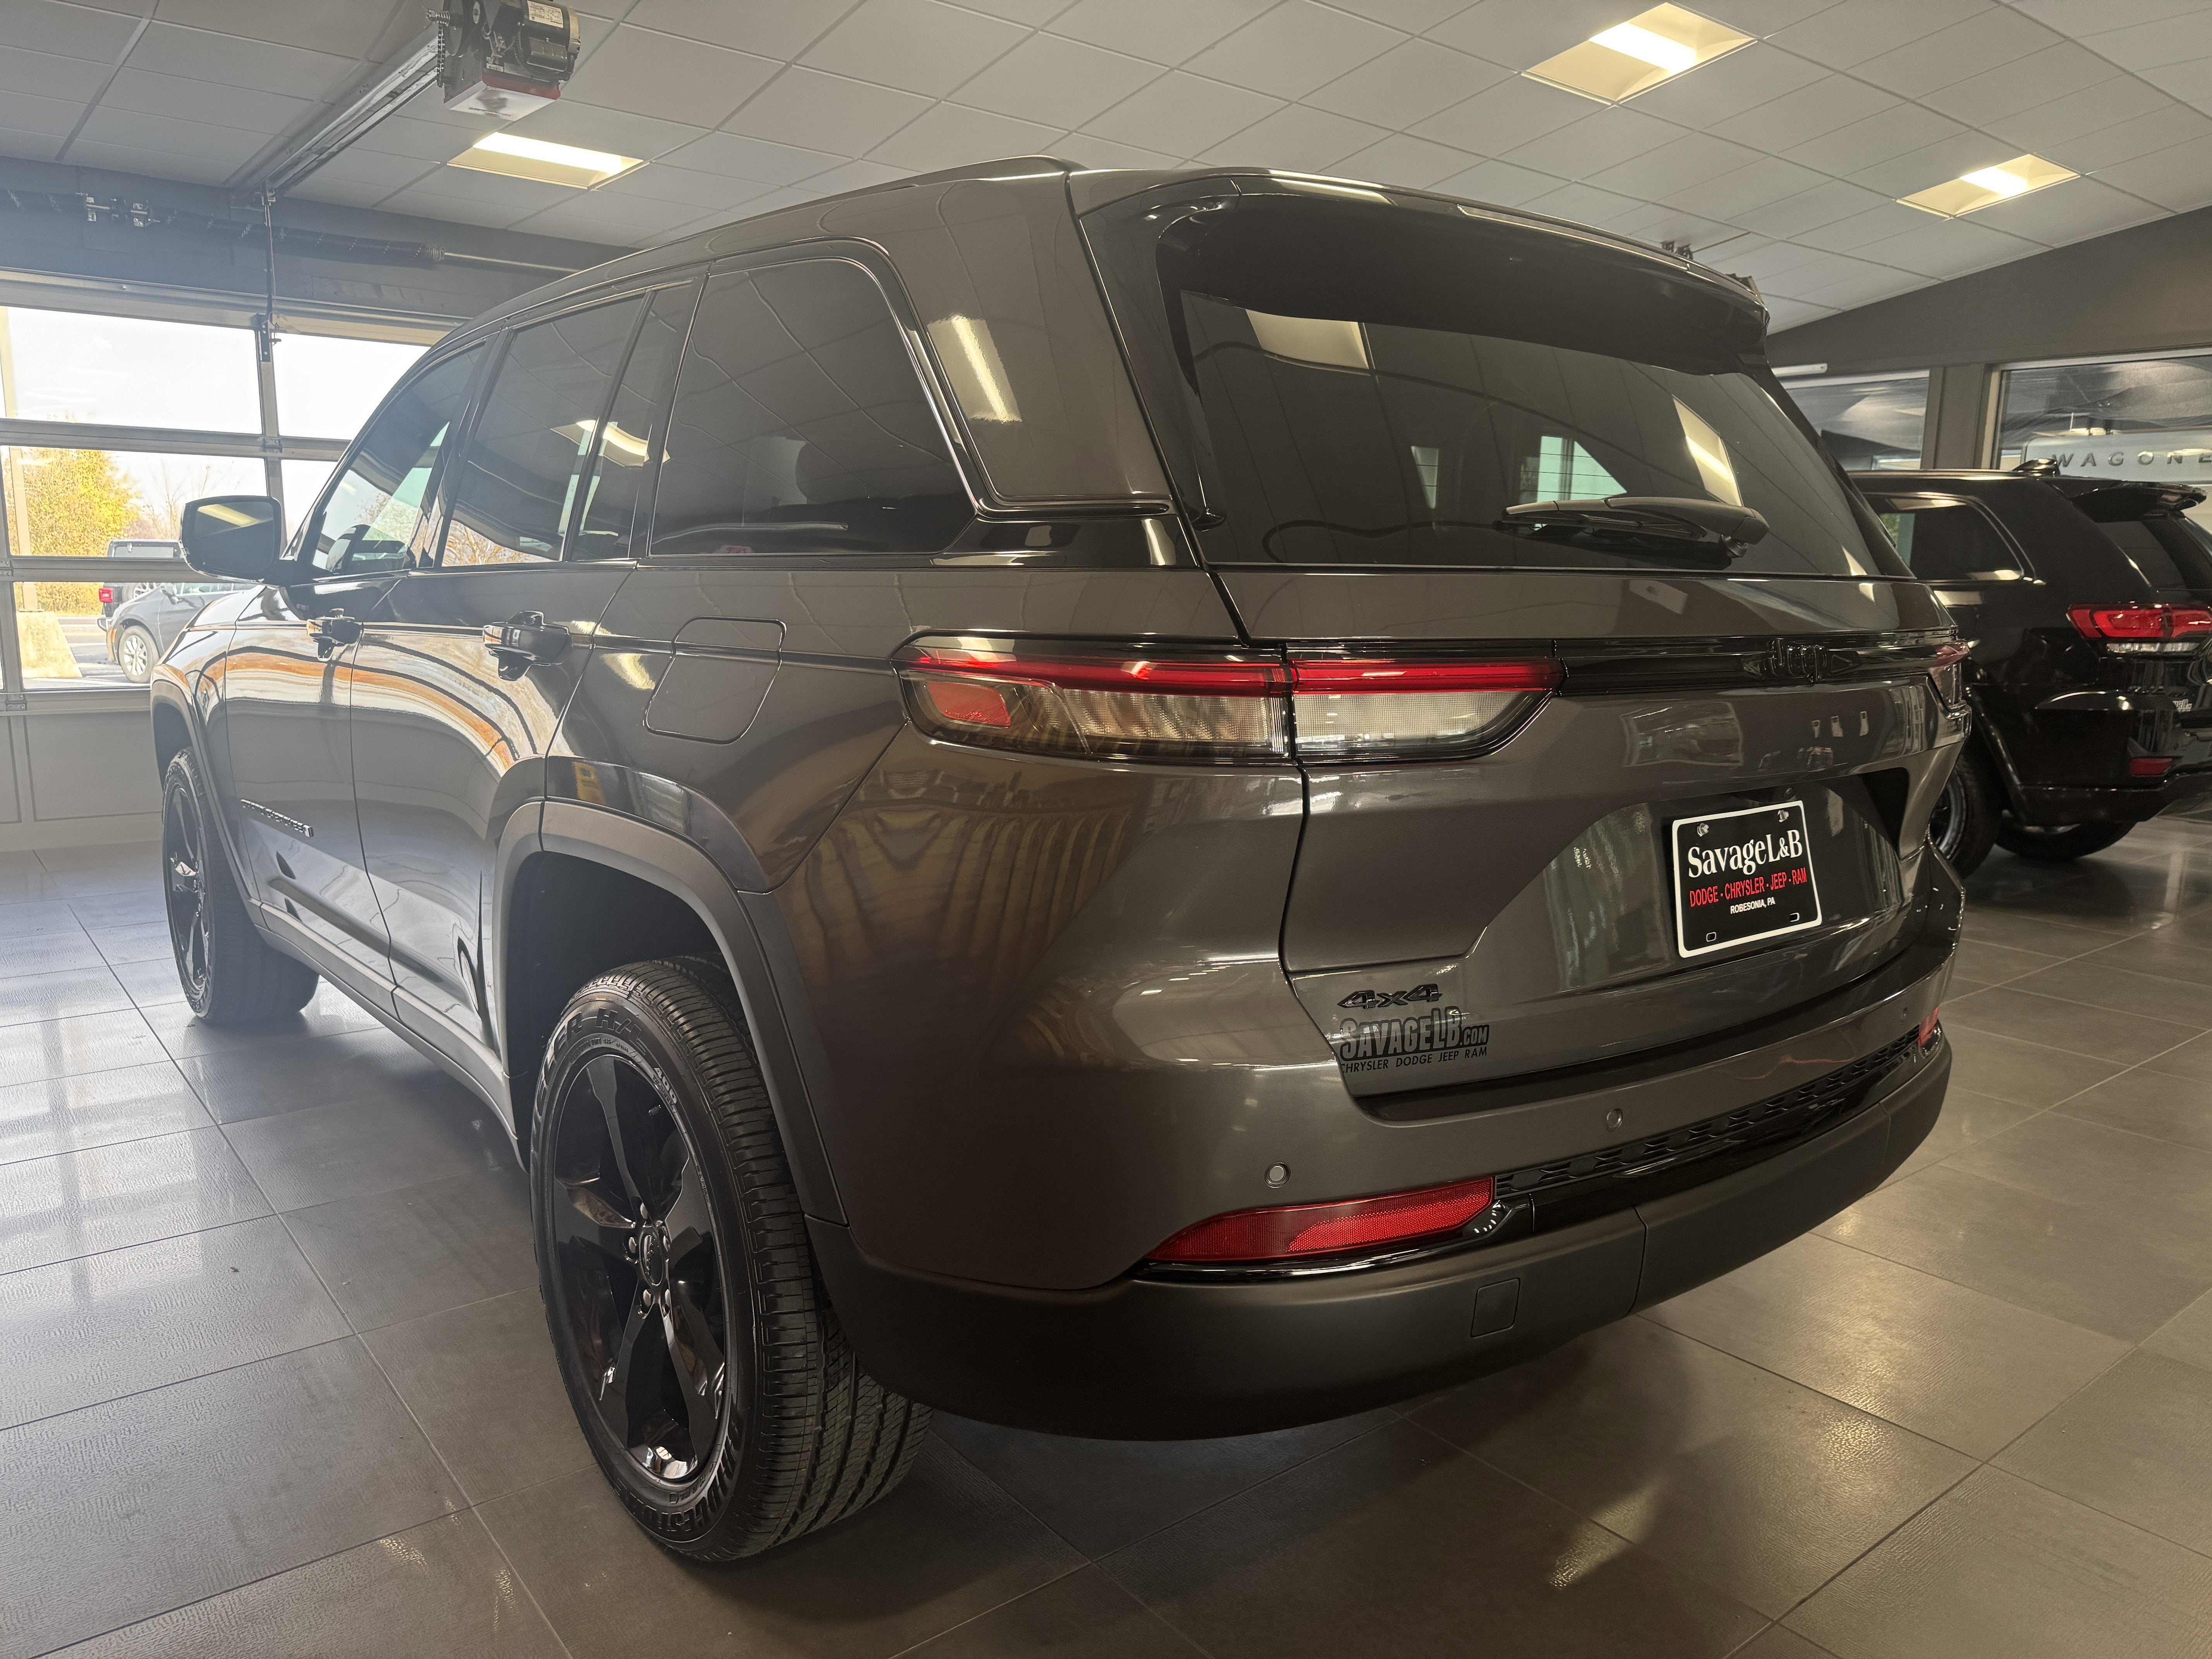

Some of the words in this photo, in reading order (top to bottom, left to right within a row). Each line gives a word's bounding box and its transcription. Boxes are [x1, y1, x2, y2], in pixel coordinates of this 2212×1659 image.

[1688, 830, 1803, 878] SavageL&B
[1689, 886, 1719, 907] DODGE
[1724, 877, 1765, 900] CHRYSLER
[1770, 872, 1787, 890] JEEP
[1792, 867, 1807, 884] RAM
[1730, 899, 1766, 914] ROBESONIA,
[1767, 896, 1776, 905] PA
[1337, 983, 1443, 1009] 4x4
[1341, 1059, 1389, 1073] CHRYSLER
[1396, 1054, 1432, 1067] DODGE
[1438, 1051, 1459, 1062] JEEP
[1465, 1046, 1487, 1058] RAM
